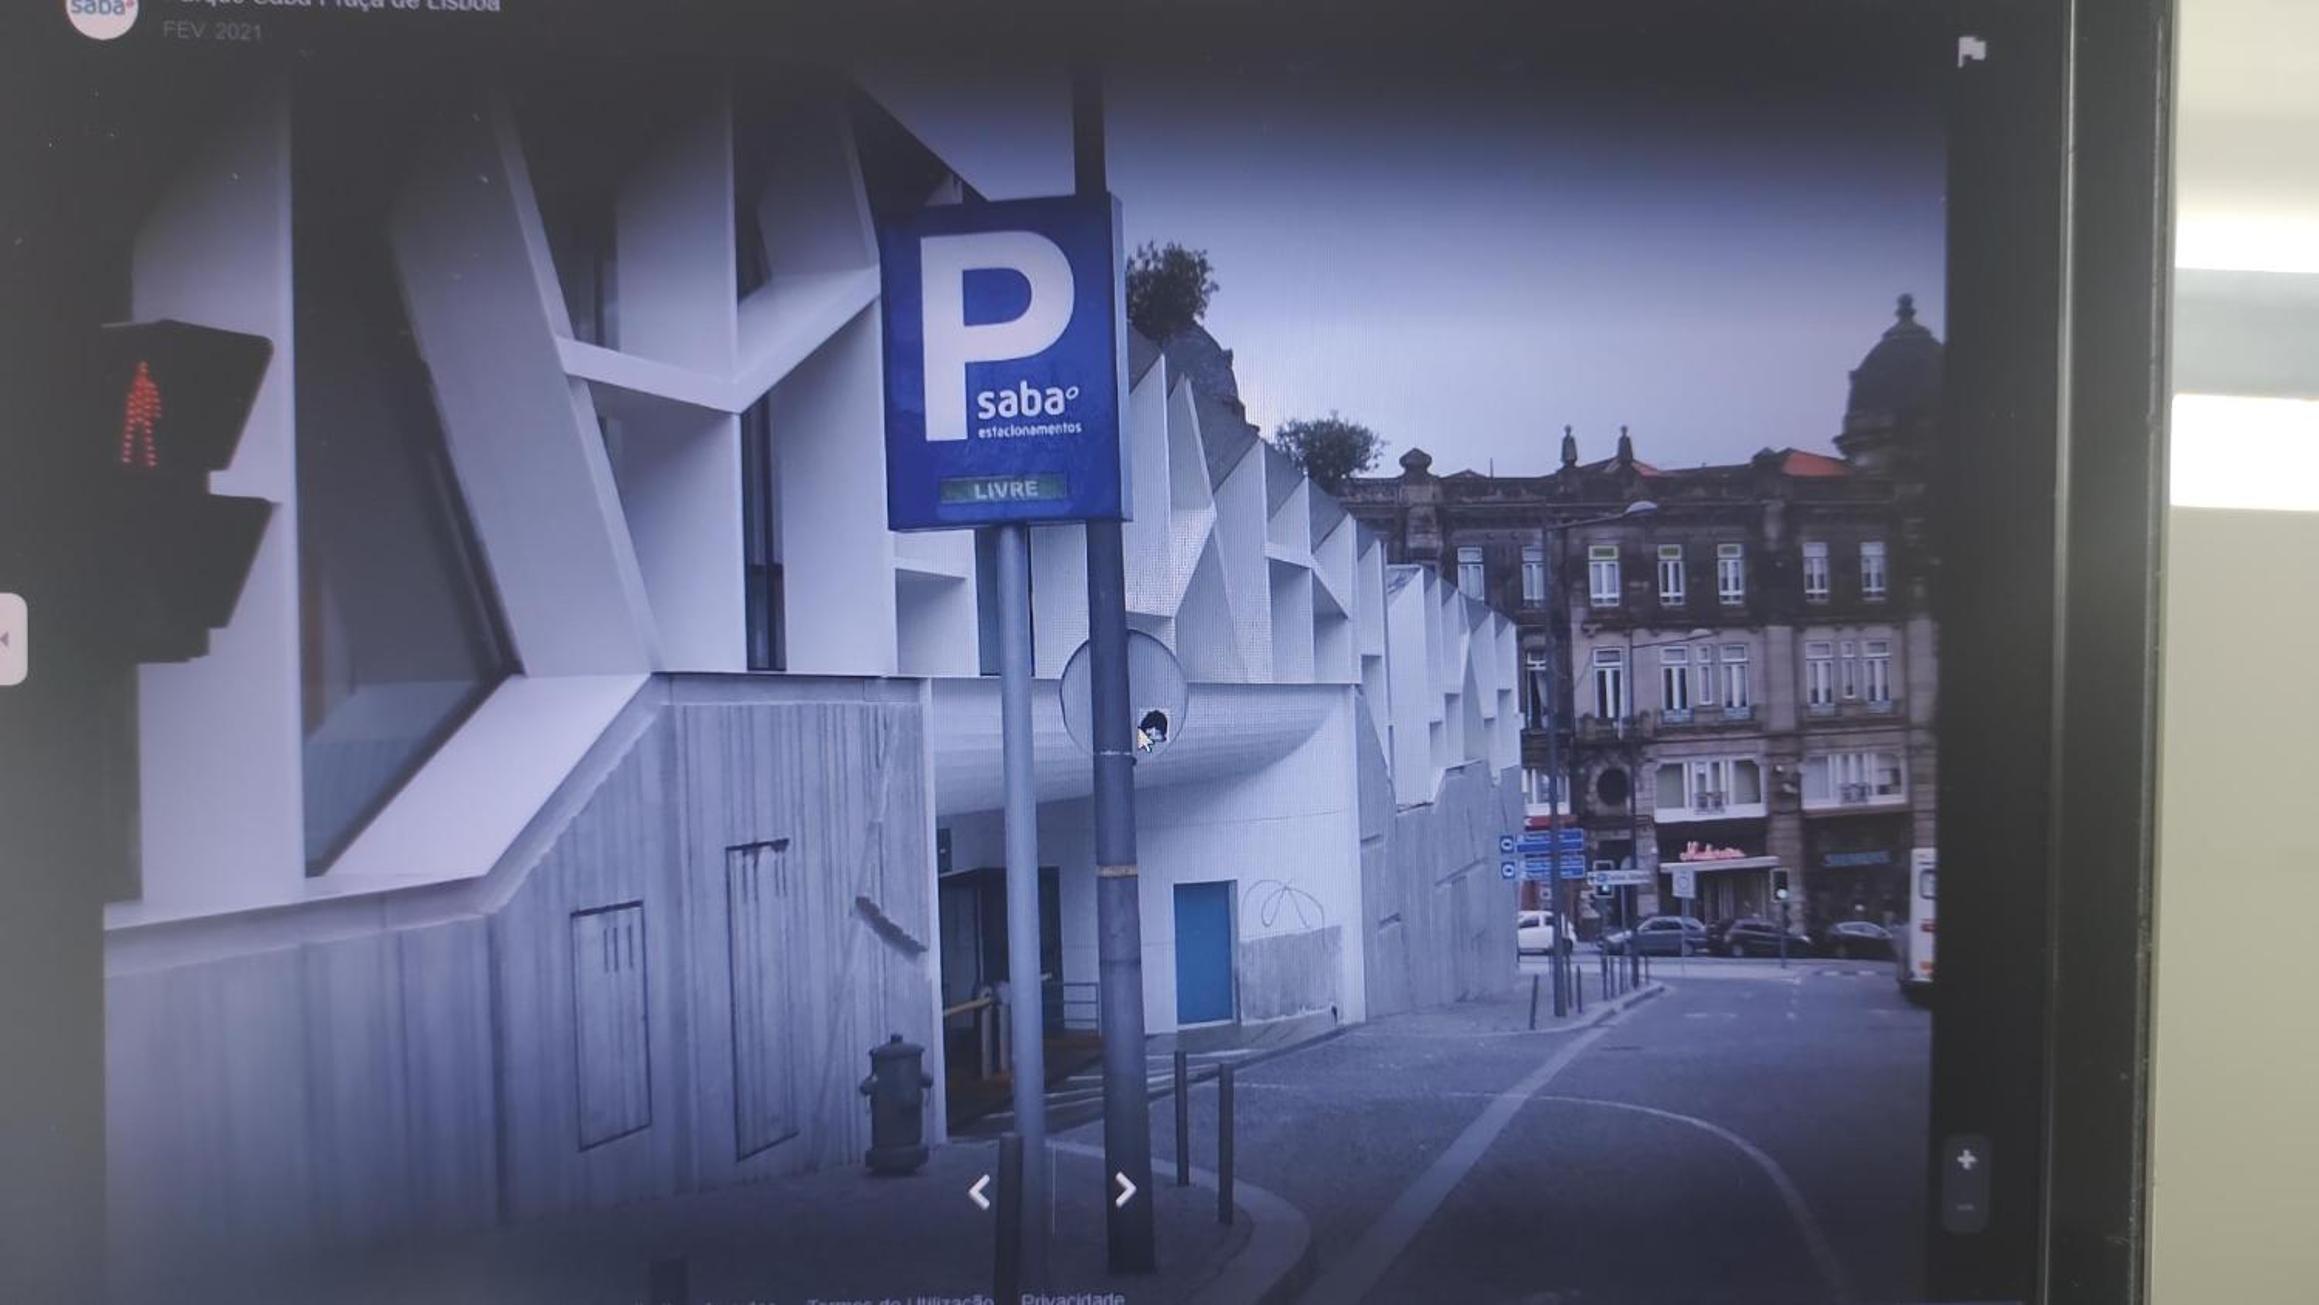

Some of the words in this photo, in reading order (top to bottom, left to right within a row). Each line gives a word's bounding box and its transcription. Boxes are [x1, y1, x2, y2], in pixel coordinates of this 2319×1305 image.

[214, 22, 260, 41] 2021
[921, 230, 1075, 442] P
[978, 422, 1082, 438] estacionamentos
[974, 480, 1039, 500] LIVRE
[1021, 1292, 1126, 1305] Privacidade
